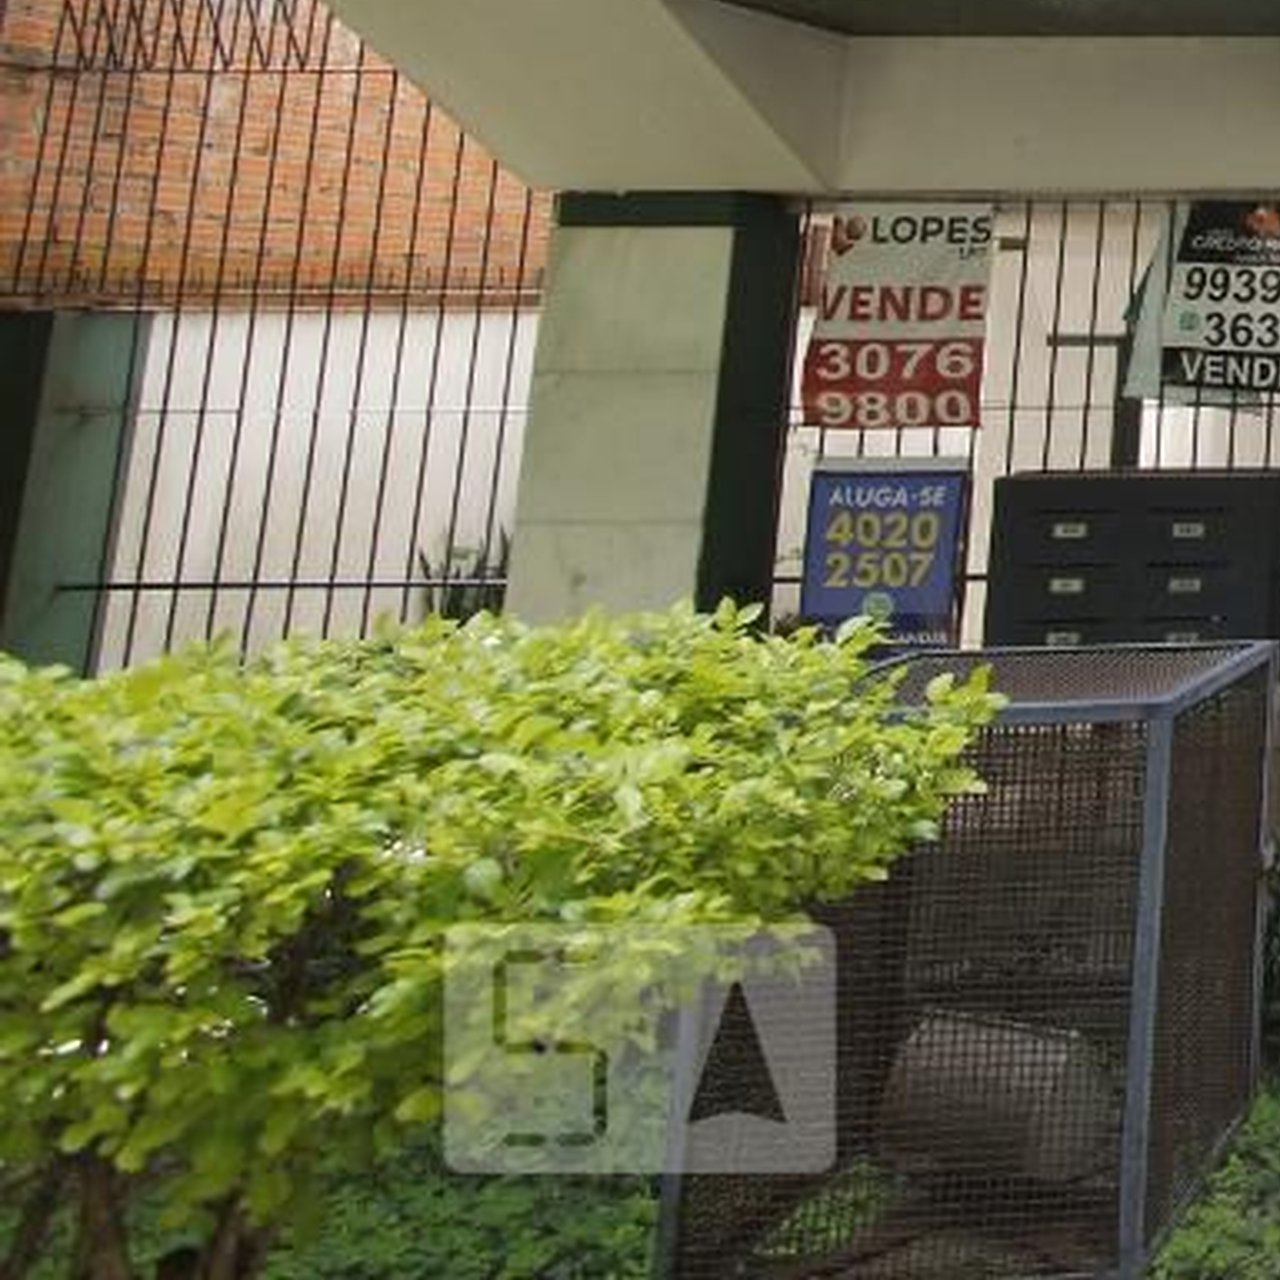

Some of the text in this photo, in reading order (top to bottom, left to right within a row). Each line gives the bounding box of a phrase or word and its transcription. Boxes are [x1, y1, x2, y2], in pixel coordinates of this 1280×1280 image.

[871, 216, 993, 244] LOPES
[823, 286, 987, 321] VENDE
[816, 342, 976, 381] 3076
[815, 390, 974, 424] 9800
[826, 511, 938, 548] 4020
